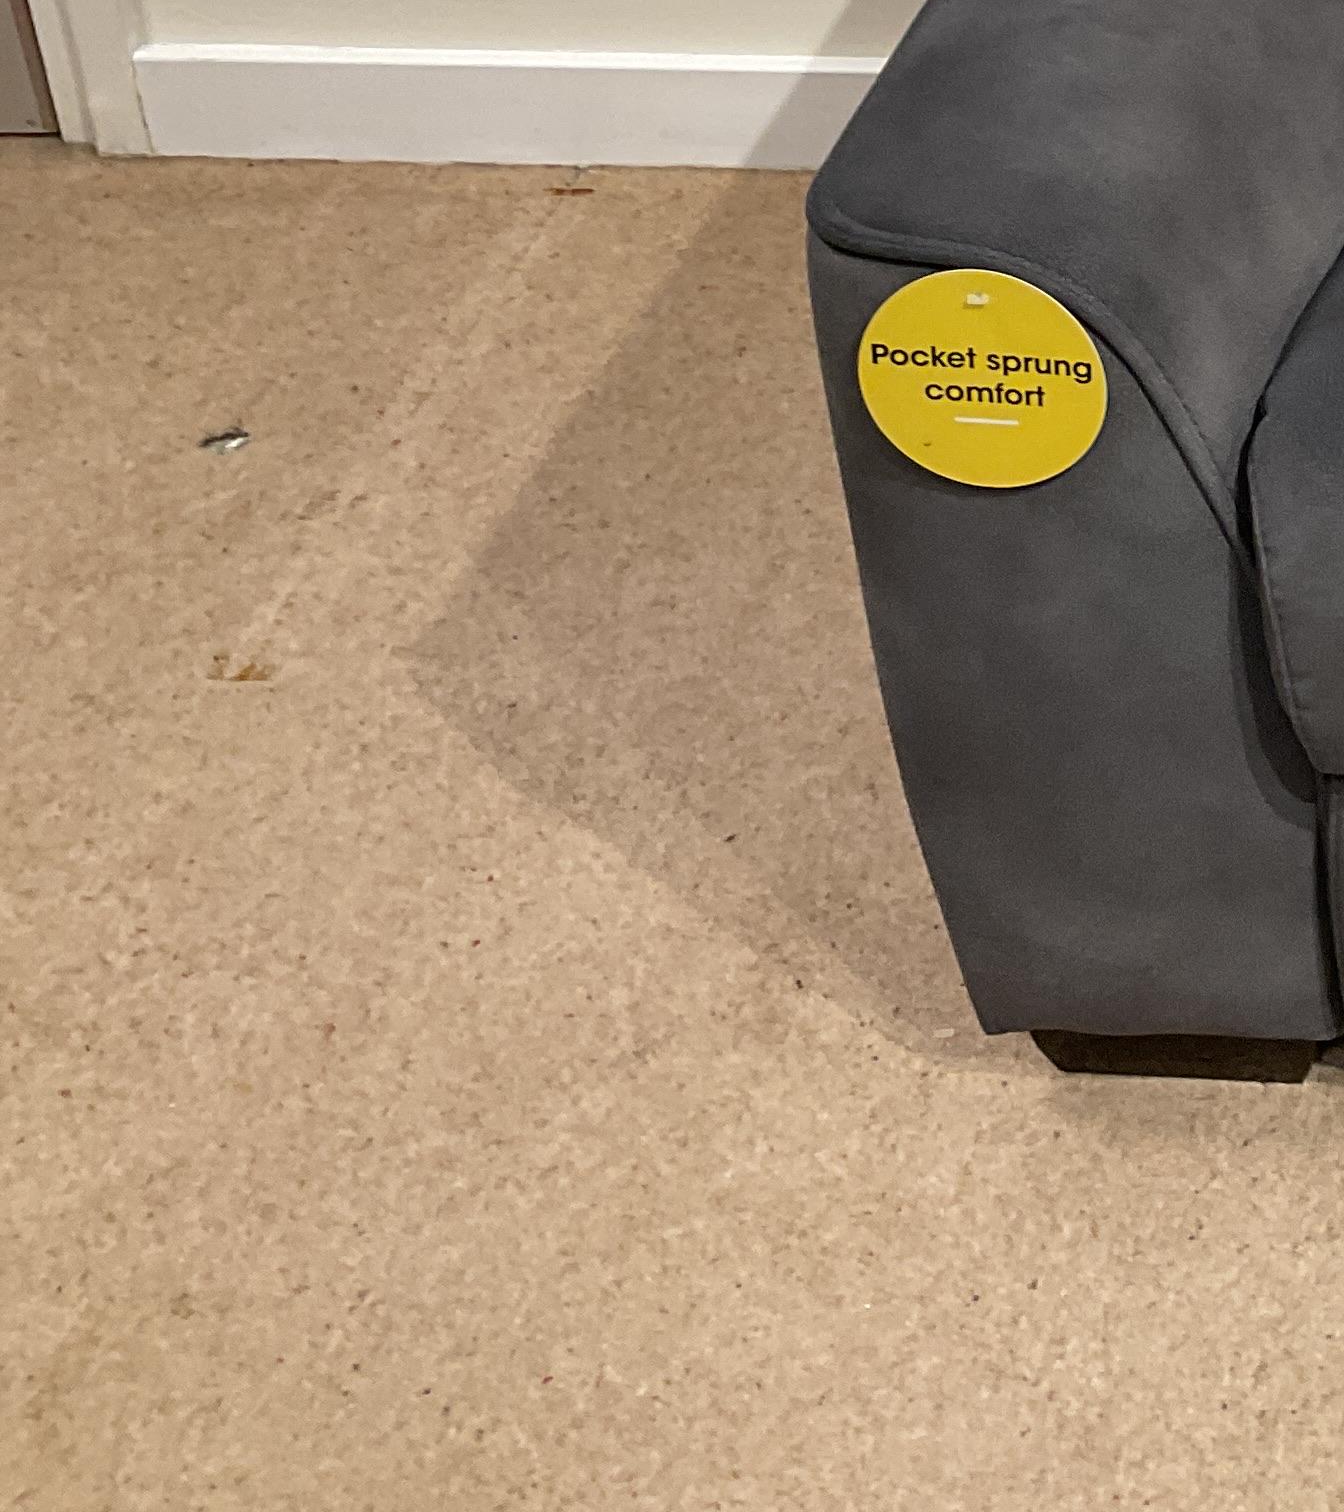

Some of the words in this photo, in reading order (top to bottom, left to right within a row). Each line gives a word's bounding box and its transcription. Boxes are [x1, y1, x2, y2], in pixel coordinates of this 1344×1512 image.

[871, 342, 976, 369] Pocket
[987, 353, 1092, 384] sprung
[924, 383, 1045, 407] comfort
